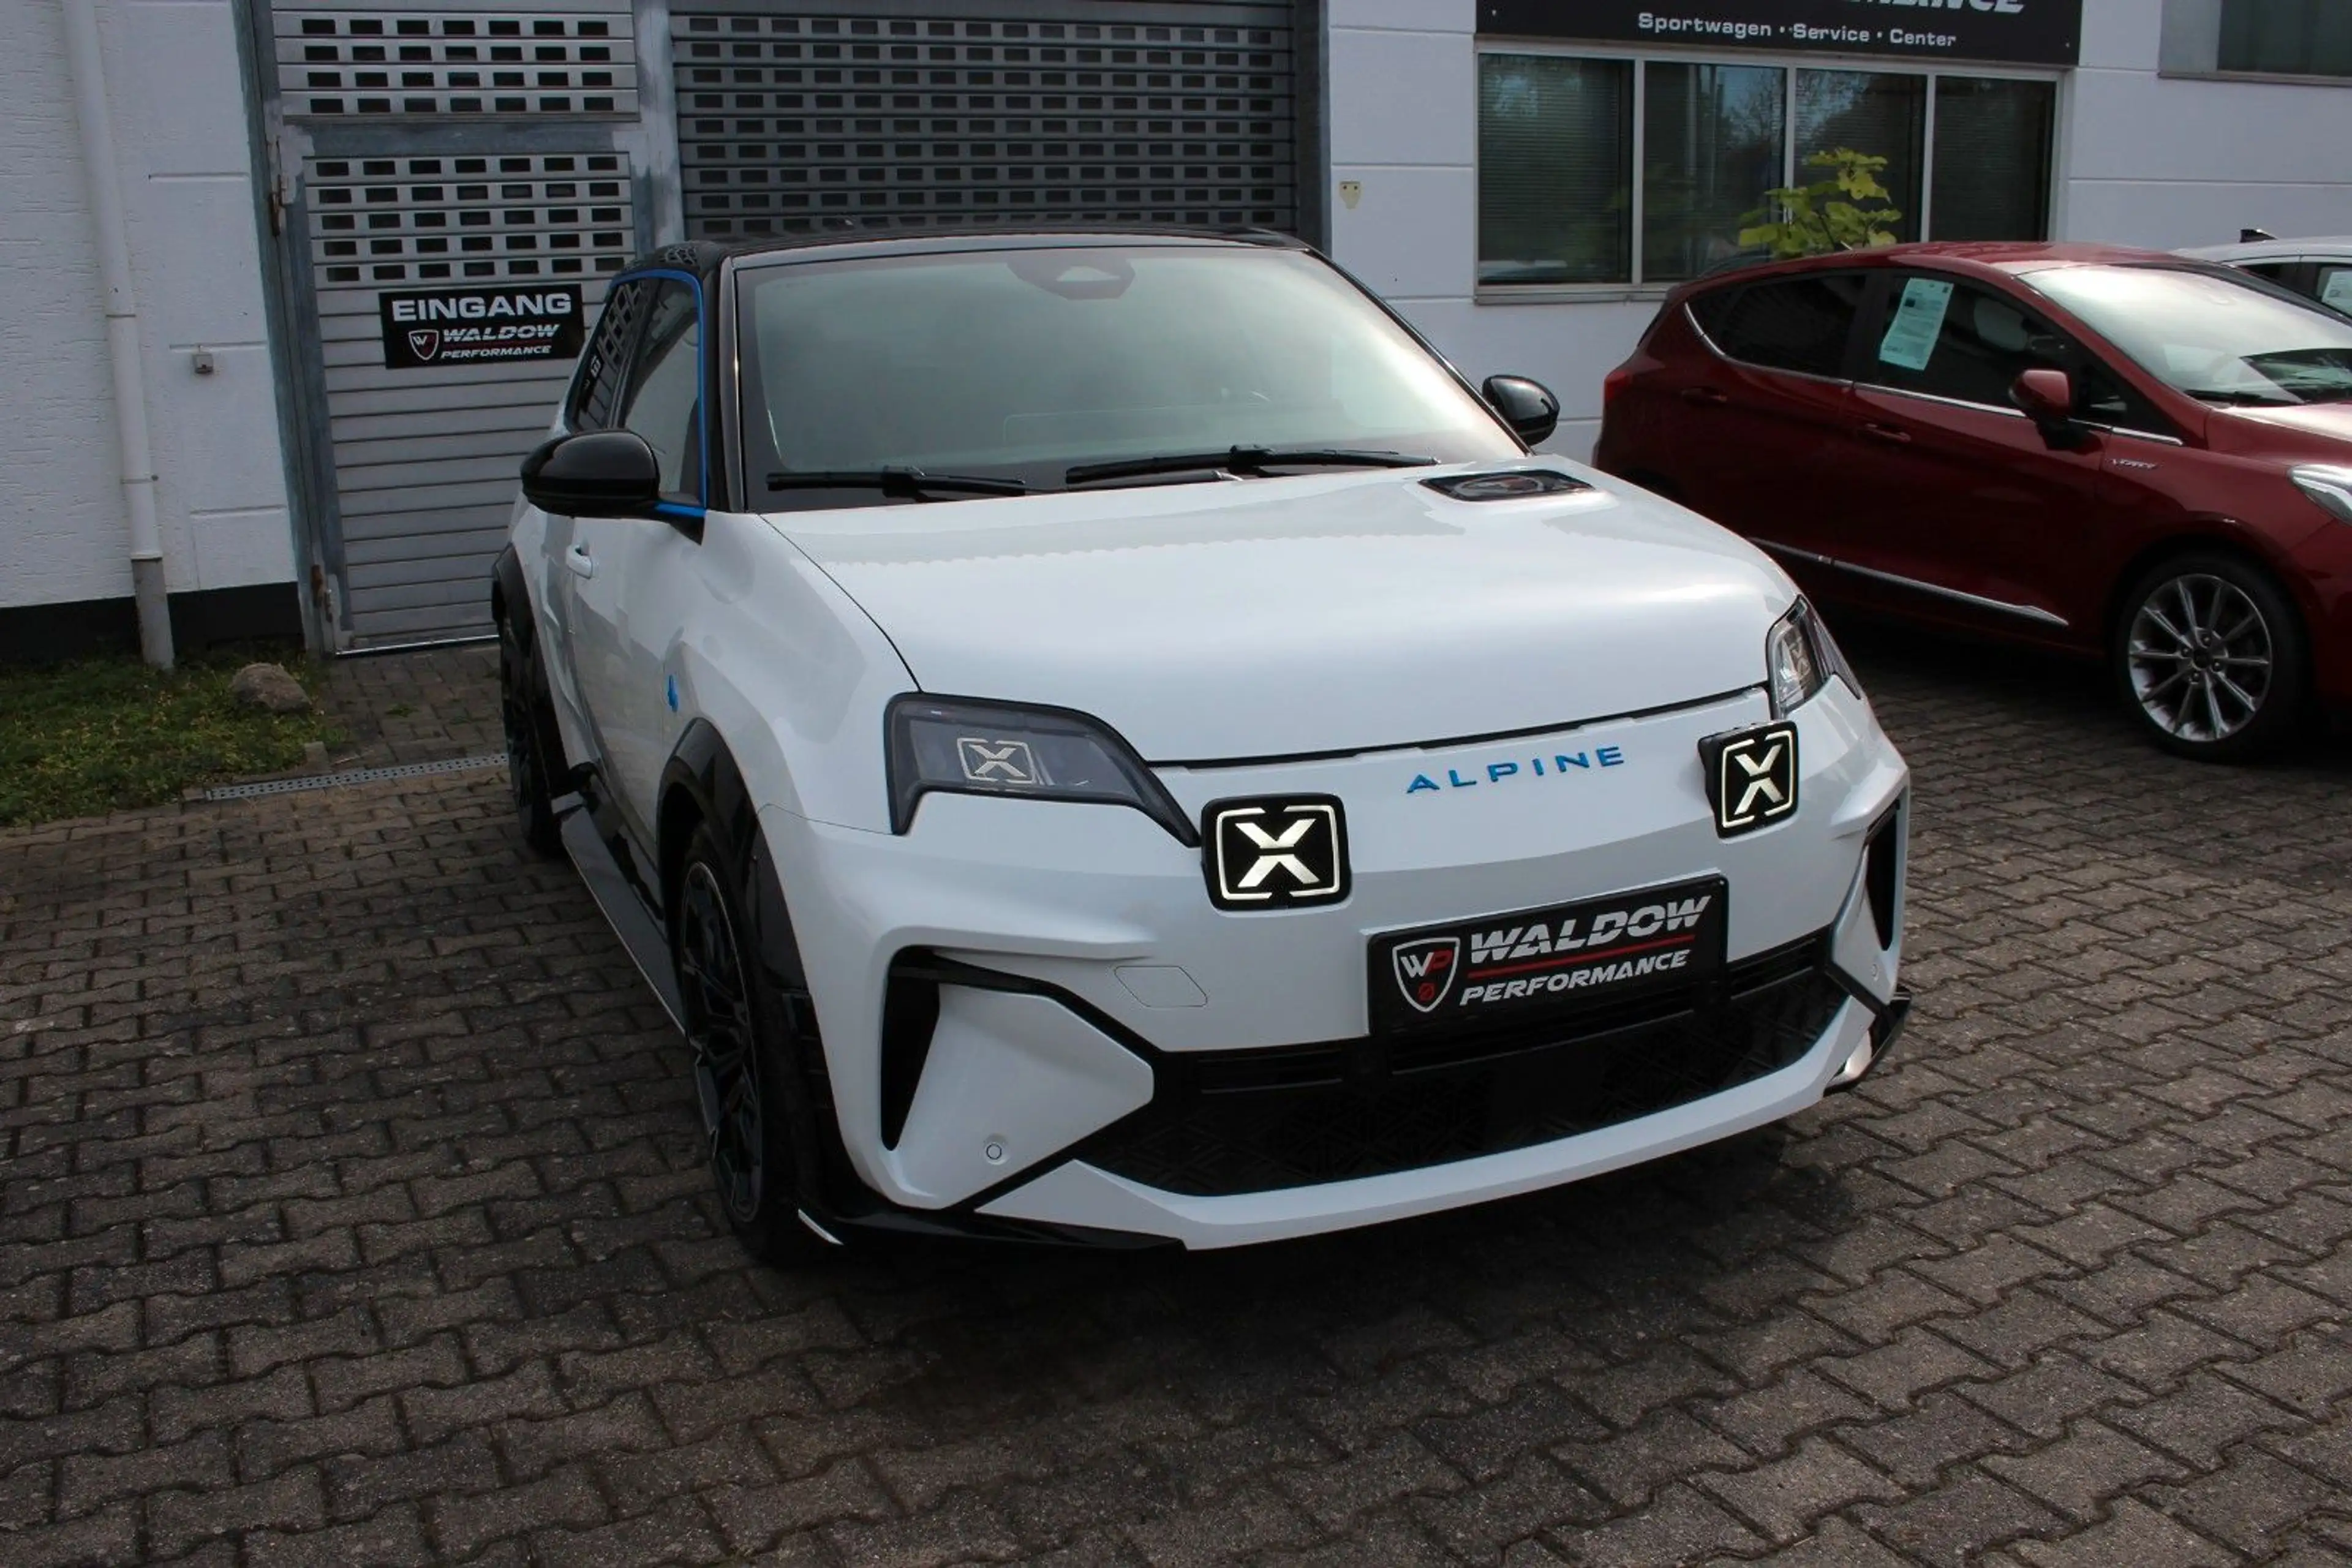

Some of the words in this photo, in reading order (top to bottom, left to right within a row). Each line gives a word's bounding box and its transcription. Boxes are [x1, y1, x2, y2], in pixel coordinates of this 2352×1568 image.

[1638, 12, 1771, 39] Sportwagen
[1793, 23, 1869, 42] Service
[1890, 28, 1957, 47] Center
[392, 293, 571, 322] EINGANG
[443, 324, 560, 342] WALDOW
[440, 345, 551, 359] PERFORMANCE
[1407, 746, 1624, 794] ALPINE
[1470, 895, 1711, 963] WALDOW
[1459, 949, 1692, 1006] PERFORMANCE
